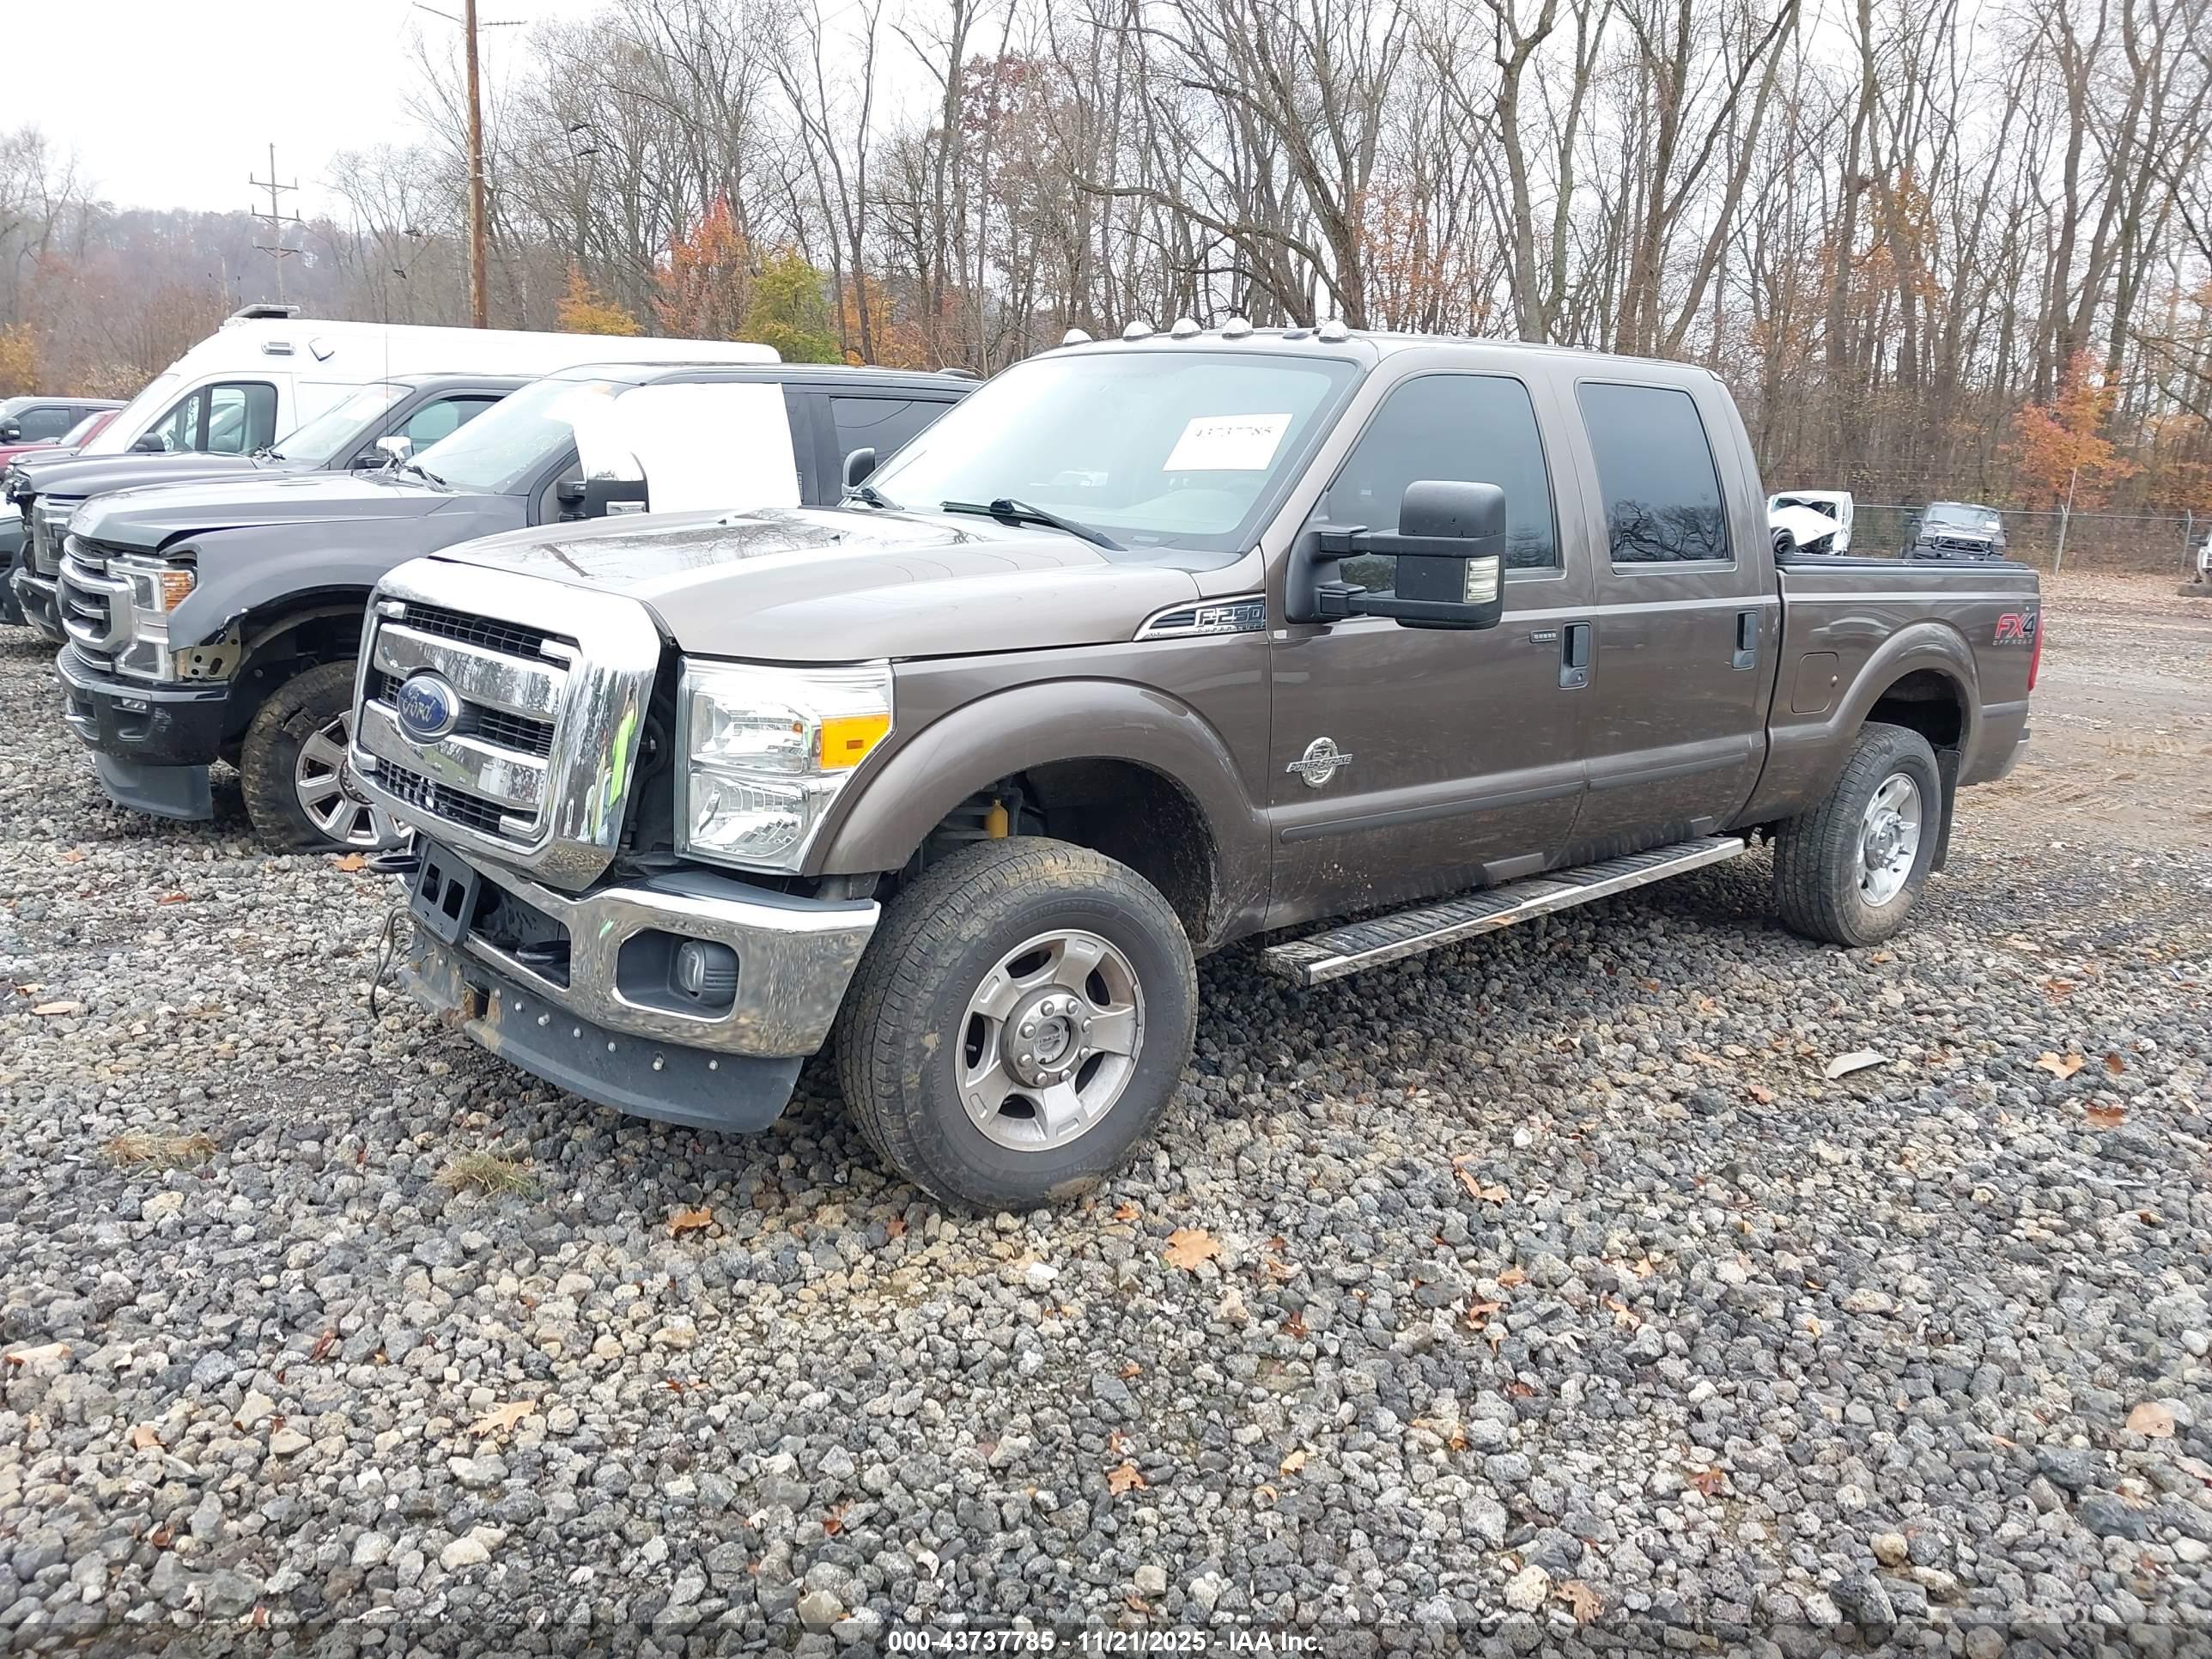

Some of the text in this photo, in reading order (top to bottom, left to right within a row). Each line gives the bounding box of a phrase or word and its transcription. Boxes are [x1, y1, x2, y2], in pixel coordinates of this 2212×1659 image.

[1194, 605, 1265, 626] F-250
[1994, 612, 2037, 639] FX4
[401, 684, 436, 722] Ford
